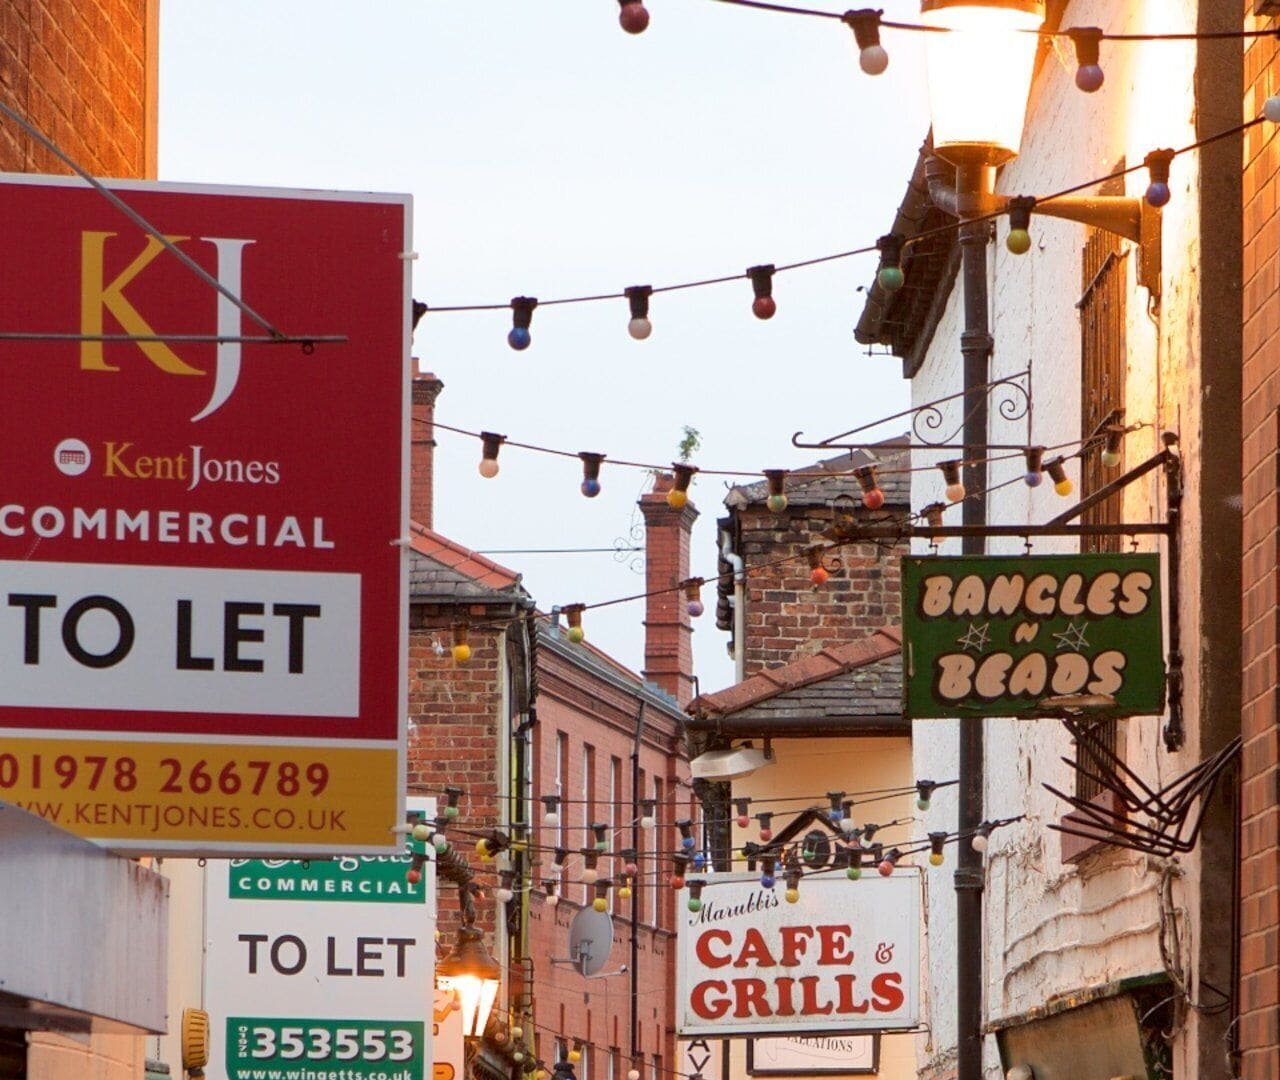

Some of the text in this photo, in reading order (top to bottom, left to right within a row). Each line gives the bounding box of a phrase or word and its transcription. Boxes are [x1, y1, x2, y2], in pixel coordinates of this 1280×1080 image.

[80, 230, 257, 423] KJ
[922, 570, 1153, 618] BANGLES
[7, 592, 322, 675] TO LET
[937, 649, 1127, 701] BEADS
[158, 757, 330, 798] 266789
[16, 800, 348, 832] W.KENTJONES.CO.UK
[238, 877, 418, 895] COMMERCIAL
[238, 934, 417, 978] TO LET
[695, 924, 895, 969] CAFE &
[689, 972, 905, 1020] GRILLS
[251, 1026, 414, 1063] 353553
